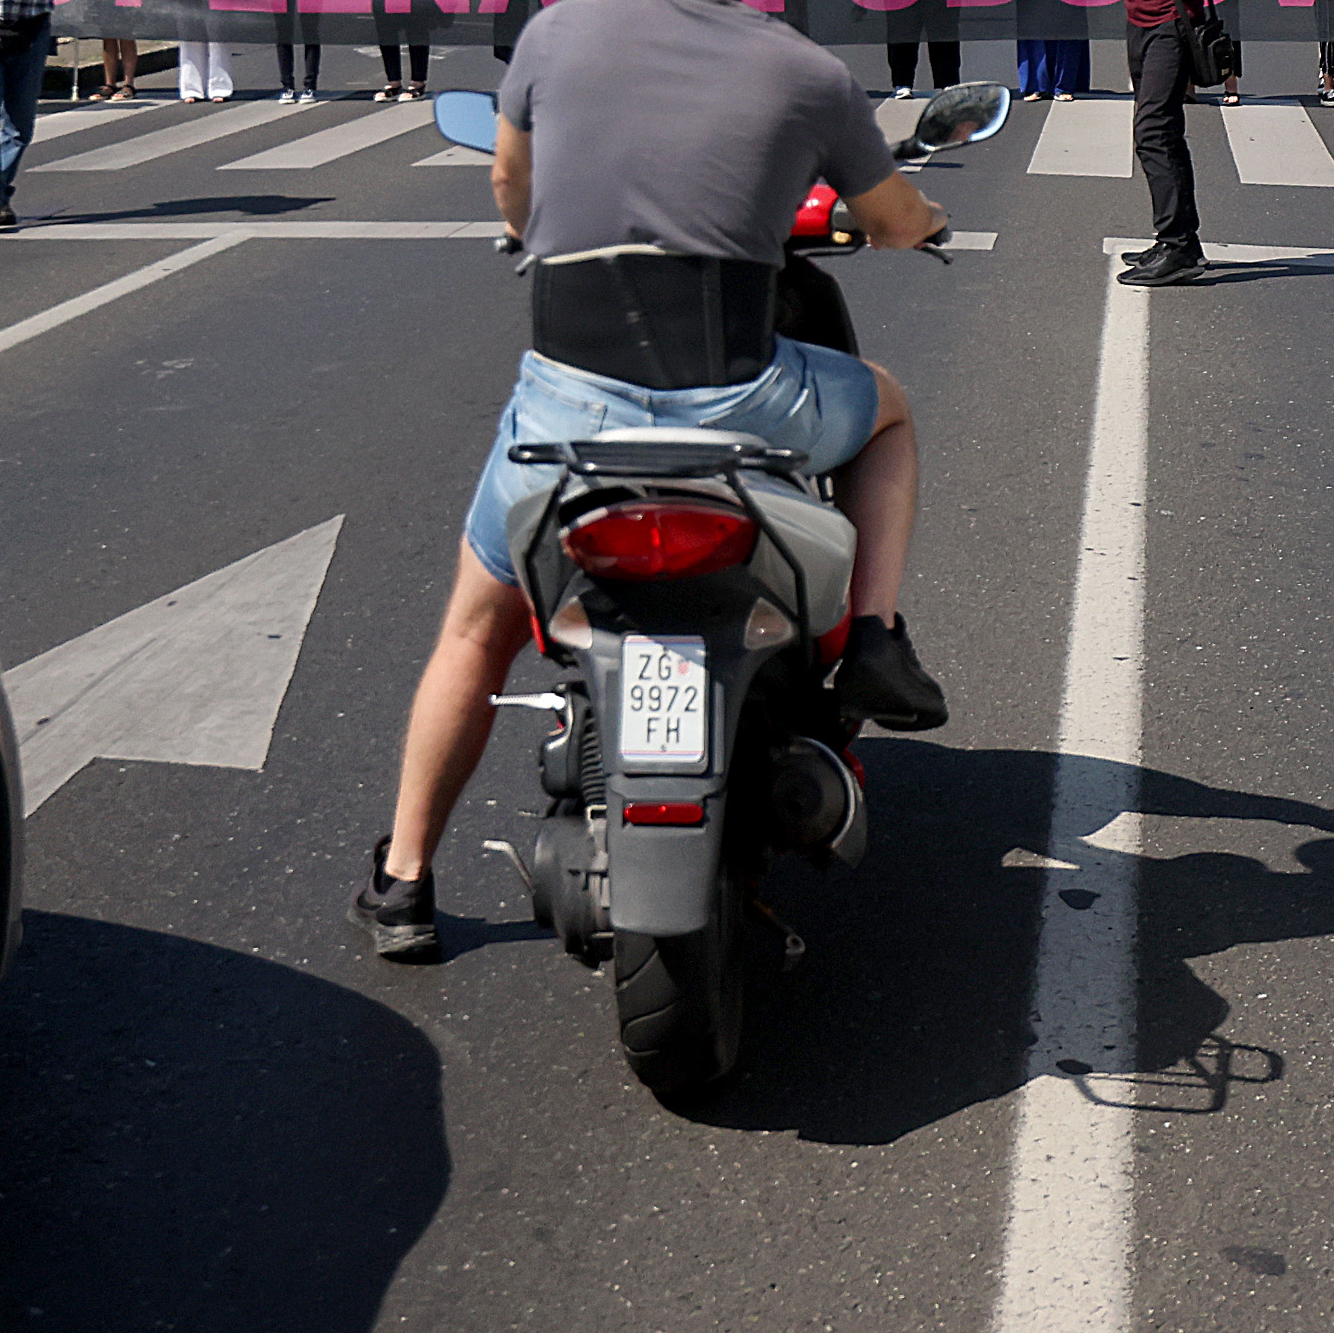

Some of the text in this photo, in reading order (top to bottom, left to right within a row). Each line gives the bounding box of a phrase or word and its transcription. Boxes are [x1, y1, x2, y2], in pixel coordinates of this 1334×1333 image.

[638, 652, 672, 680] ZG
[630, 685, 699, 712] 9972
[646, 717, 681, 743] FH
